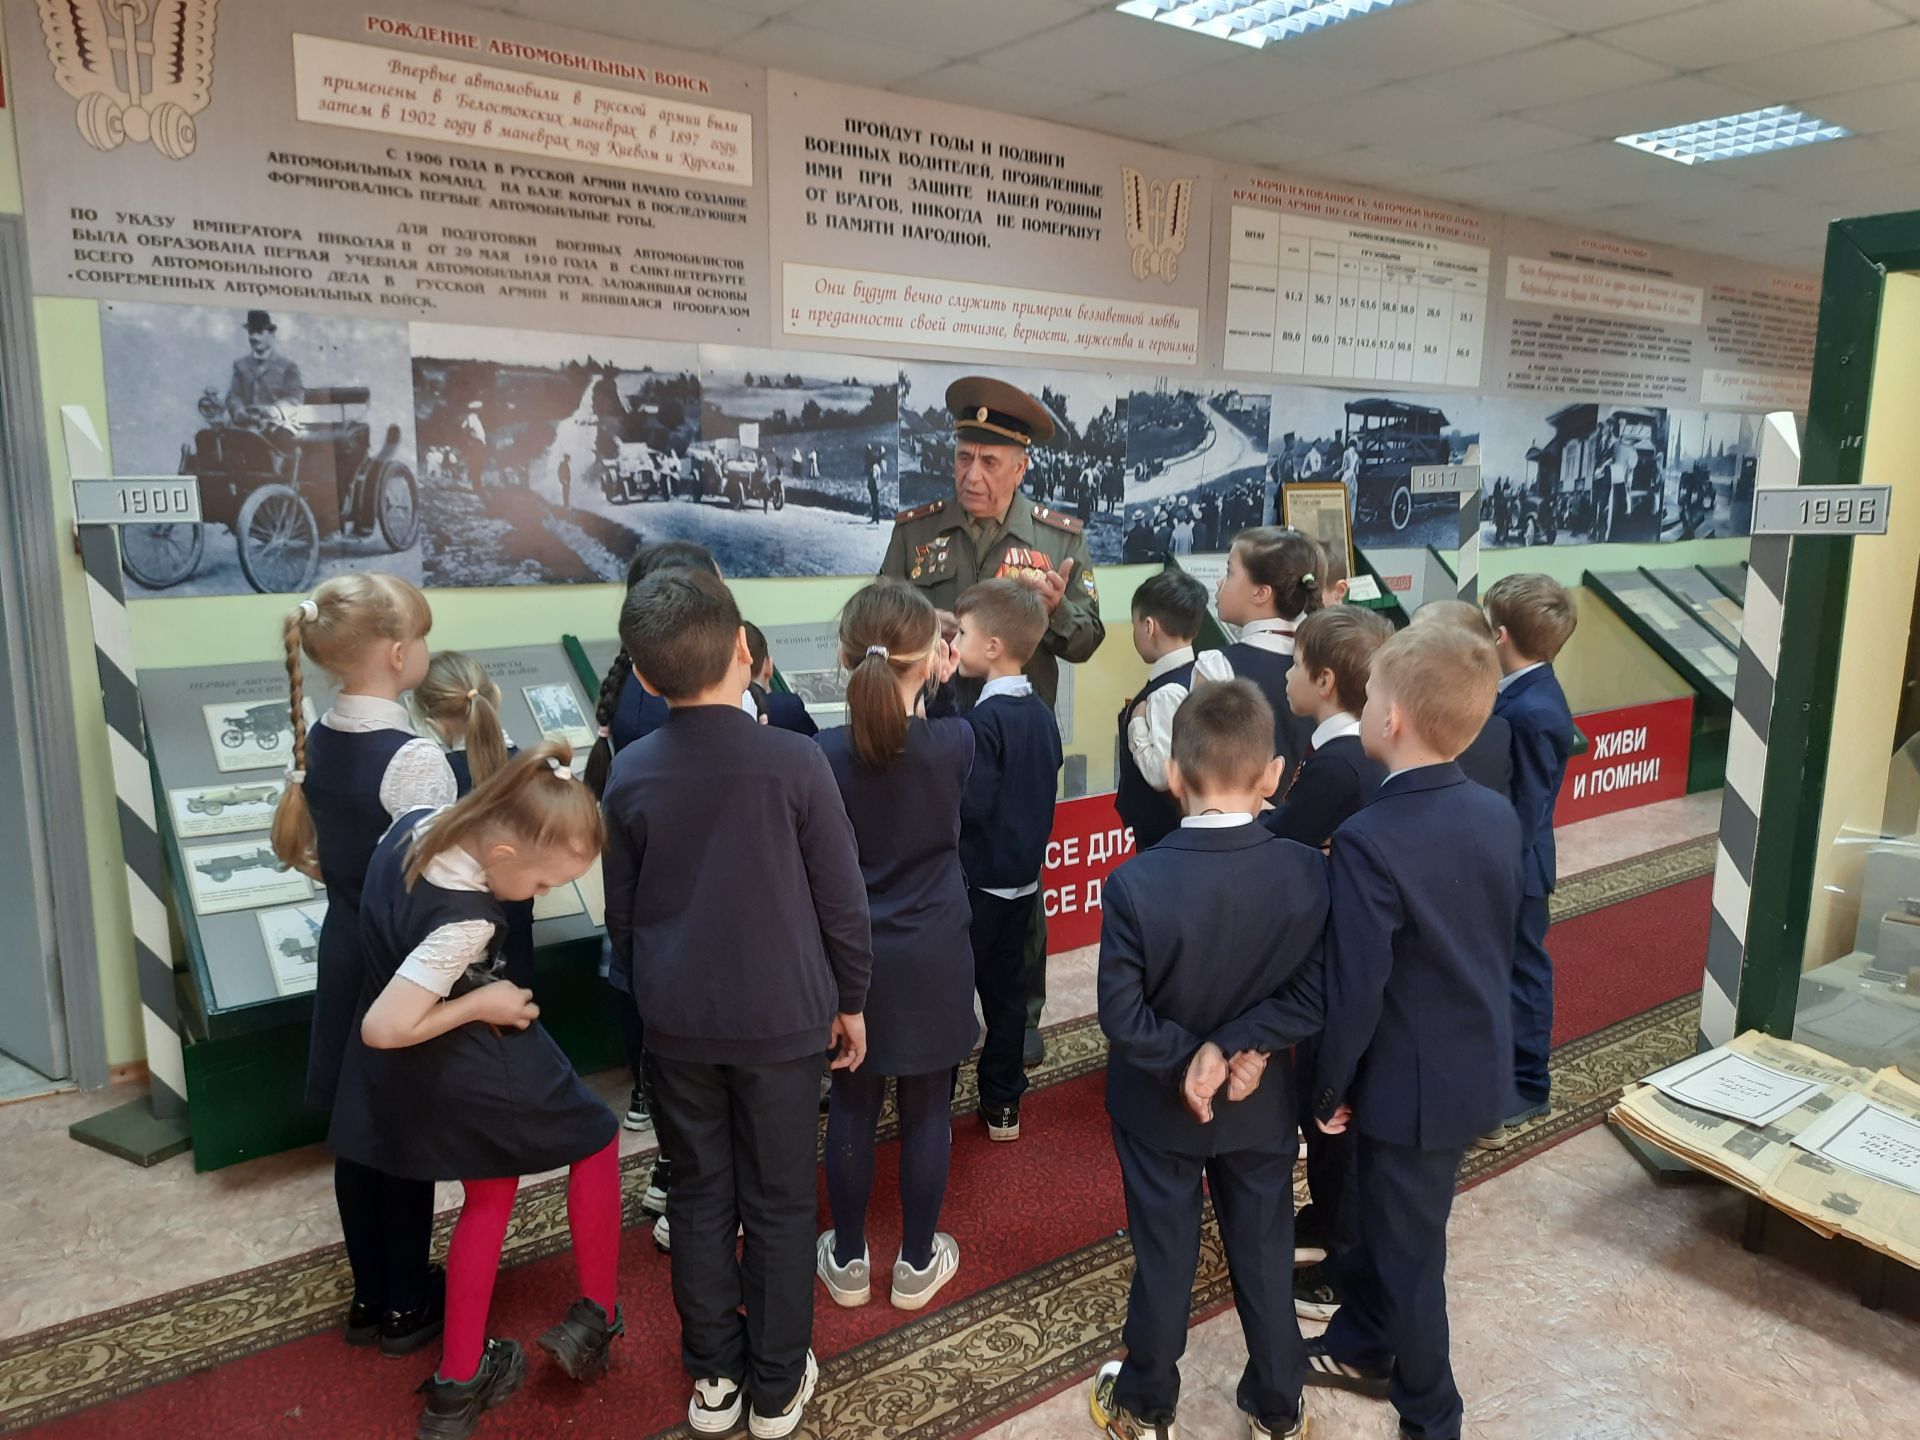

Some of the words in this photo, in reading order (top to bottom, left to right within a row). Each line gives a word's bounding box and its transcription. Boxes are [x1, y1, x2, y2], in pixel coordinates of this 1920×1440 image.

[367, 16, 479, 49] РОЖДЕНИЕ
[488, 39, 646, 81] АВТОМОБИЛЬНЫХ
[654, 71, 710, 93] ВОЙСК
[323, 76, 416, 101] применены
[433, 89, 442, 104] в
[456, 94, 563, 126] Белостокских
[571, 115, 637, 138] маневрах
[649, 127, 657, 139] в
[670, 131, 700, 147] 1897
[711, 141, 738, 157] году.
[388, 58, 457, 84] Впервые
[464, 72, 559, 101] автомобили
[573, 90, 582, 104] в
[594, 98, 646, 116] русской
[659, 110, 701, 126] армии
[707, 114, 738, 132] были
[318, 99, 372, 117] затем
[381, 104, 390, 119] в
[400, 108, 436, 126] 1902
[444, 120, 476, 136] году
[484, 120, 492, 136] в
[499, 126, 569, 150] маневрах
[576, 137, 600, 155] под
[607, 139, 659, 160] Киевом
[665, 153, 673, 164] и
[680, 152, 738, 173] Курском.
[844, 118, 922, 145] ПРОЙДУТ
[930, 130, 974, 154] ГОДЫ
[981, 139, 991, 156] И
[998, 144, 1066, 170] ПОДВИГИ
[267, 151, 412, 180] АВТОМОБИЛЬНЫХ
[500, 178, 520, 194] НА
[527, 186, 562, 200] БАЗЕ
[568, 192, 631, 209] КОТОРЫХ
[638, 200, 646, 210] В
[651, 202, 747, 224] ПОСЛЕДУЮЩЕМ
[386, 148, 397, 160] С
[406, 151, 442, 166] 1906
[449, 156, 487, 173] ГОДА
[494, 162, 504, 174] В
[511, 164, 575, 184] РУССКОЙ
[581, 175, 627, 191] АРМИИ
[632, 182, 680, 198] НАЧАТО
[684, 190, 747, 208] СОЗДАНИЕ
[804, 136, 891, 164] ВОЕННЫХ
[898, 150, 994, 180] ВОДИТЕЛЕЙ,
[1002, 168, 1104, 198] ПРОЯВЛЕННЫЕ
[805, 161, 843, 181] ИМИ
[858, 169, 893, 188] ПРИ
[907, 177, 973, 201] ЗАЩИТЕ
[986, 187, 1039, 210] НАШЕЙ
[1045, 197, 1103, 220] РОДИНЫ
[268, 171, 413, 200] ФОРМИРОВАЛИСЬ
[420, 190, 481, 208] ПЕРВЫЕ
[488, 198, 611, 223] АВТОМОБИЛЬНЫЕ
[617, 214, 656, 228] РОТЫ.
[805, 186, 828, 204] ОТ
[835, 189, 904, 215] ВРАГОВ,
[911, 201, 983, 226] НИКОГДА
[996, 213, 1015, 230] НЕ
[1021, 216, 1103, 243] ПОМЕРКНУТ
[70, 206, 98, 222] ПО
[116, 211, 176, 229] УКАЗУ
[193, 218, 302, 242] ИМПЕРАТОРА
[317, 232, 394, 252] НИКОЛАЯ
[428, 242, 447, 255] ОТ
[454, 245, 472, 258] 29
[479, 248, 510, 262] МАЯ
[524, 252, 558, 267] 1910
[562, 256, 598, 272] ГОДА
[610, 262, 619, 273] В
[396, 222, 428, 236] ДЛЯ
[442, 226, 537, 248] ПОДГОТОВКИ
[556, 239, 622, 256] ВОЕННЫХ
[634, 248, 744, 270] АВТОМОБИЛИСТОВ
[806, 210, 818, 228] В
[825, 214, 895, 238] ПАМЯТИ
[901, 223, 991, 250] НАРОДНОЙ.
[72, 228, 128, 246] БЫЛА
[136, 234, 256, 256] ОБРАЗОВАНА
[264, 246, 330, 264] ПЕРВАЯ
[344, 253, 418, 271] УЧЕБНАЯ
[425, 260, 552, 284] АВТОМОБИЛЬНАЯ
[600, 276, 691, 297] ЗАЛОЖИВШАЯ
[696, 287, 747, 302] ОСНОВЫ
[74, 248, 134, 266] ВСЕГО
[152, 254, 312, 280] АВТОМОБИЛЬНОГО
[326, 270, 370, 286] ДЕЛА
[384, 275, 394, 286] В
[415, 278, 485, 294] РУССКОЙ
[498, 286, 548, 300] АРМИИ
[560, 291, 569, 302] И
[581, 292, 662, 310] ЯВИВШАЯСЯ
[672, 301, 750, 318] ПРООБРАЗОМ
[76, 268, 216, 292] СОВРЕМЕННЫХ
[224, 280, 373, 304] АВТОМОБИЛЬНЫХ
[380, 293, 437, 309] ВОЙСК.
[791, 306, 801, 320] и
[807, 309, 904, 329] преданности
[910, 314, 947, 332] своей
[952, 320, 1008, 340] отчизне,
[1013, 322, 1070, 346] верности,
[1074, 329, 1134, 350] мужества
[1138, 338, 1145, 349] и
[814, 277, 845, 296] Они
[853, 280, 897, 305] будут
[903, 285, 943, 306] вечно
[948, 293, 1008, 313] служить
[1011, 300, 1073, 320] примером
[1077, 303, 1145, 327] беззаветной
[1148, 311, 1181, 330] любви
[118, 488, 189, 514] 1900
[1420, 471, 1458, 487] 1917
[1800, 498, 1876, 524] 1996
[1594, 726, 1648, 760] ЖИВИ
[1573, 773, 1586, 800] И
[1590, 757, 1661, 796] ПОМНИ!
[1044, 837, 1080, 870] СЕ
[1087, 826, 1136, 867] ДЛЯ
[1042, 884, 1077, 917] СЕ
